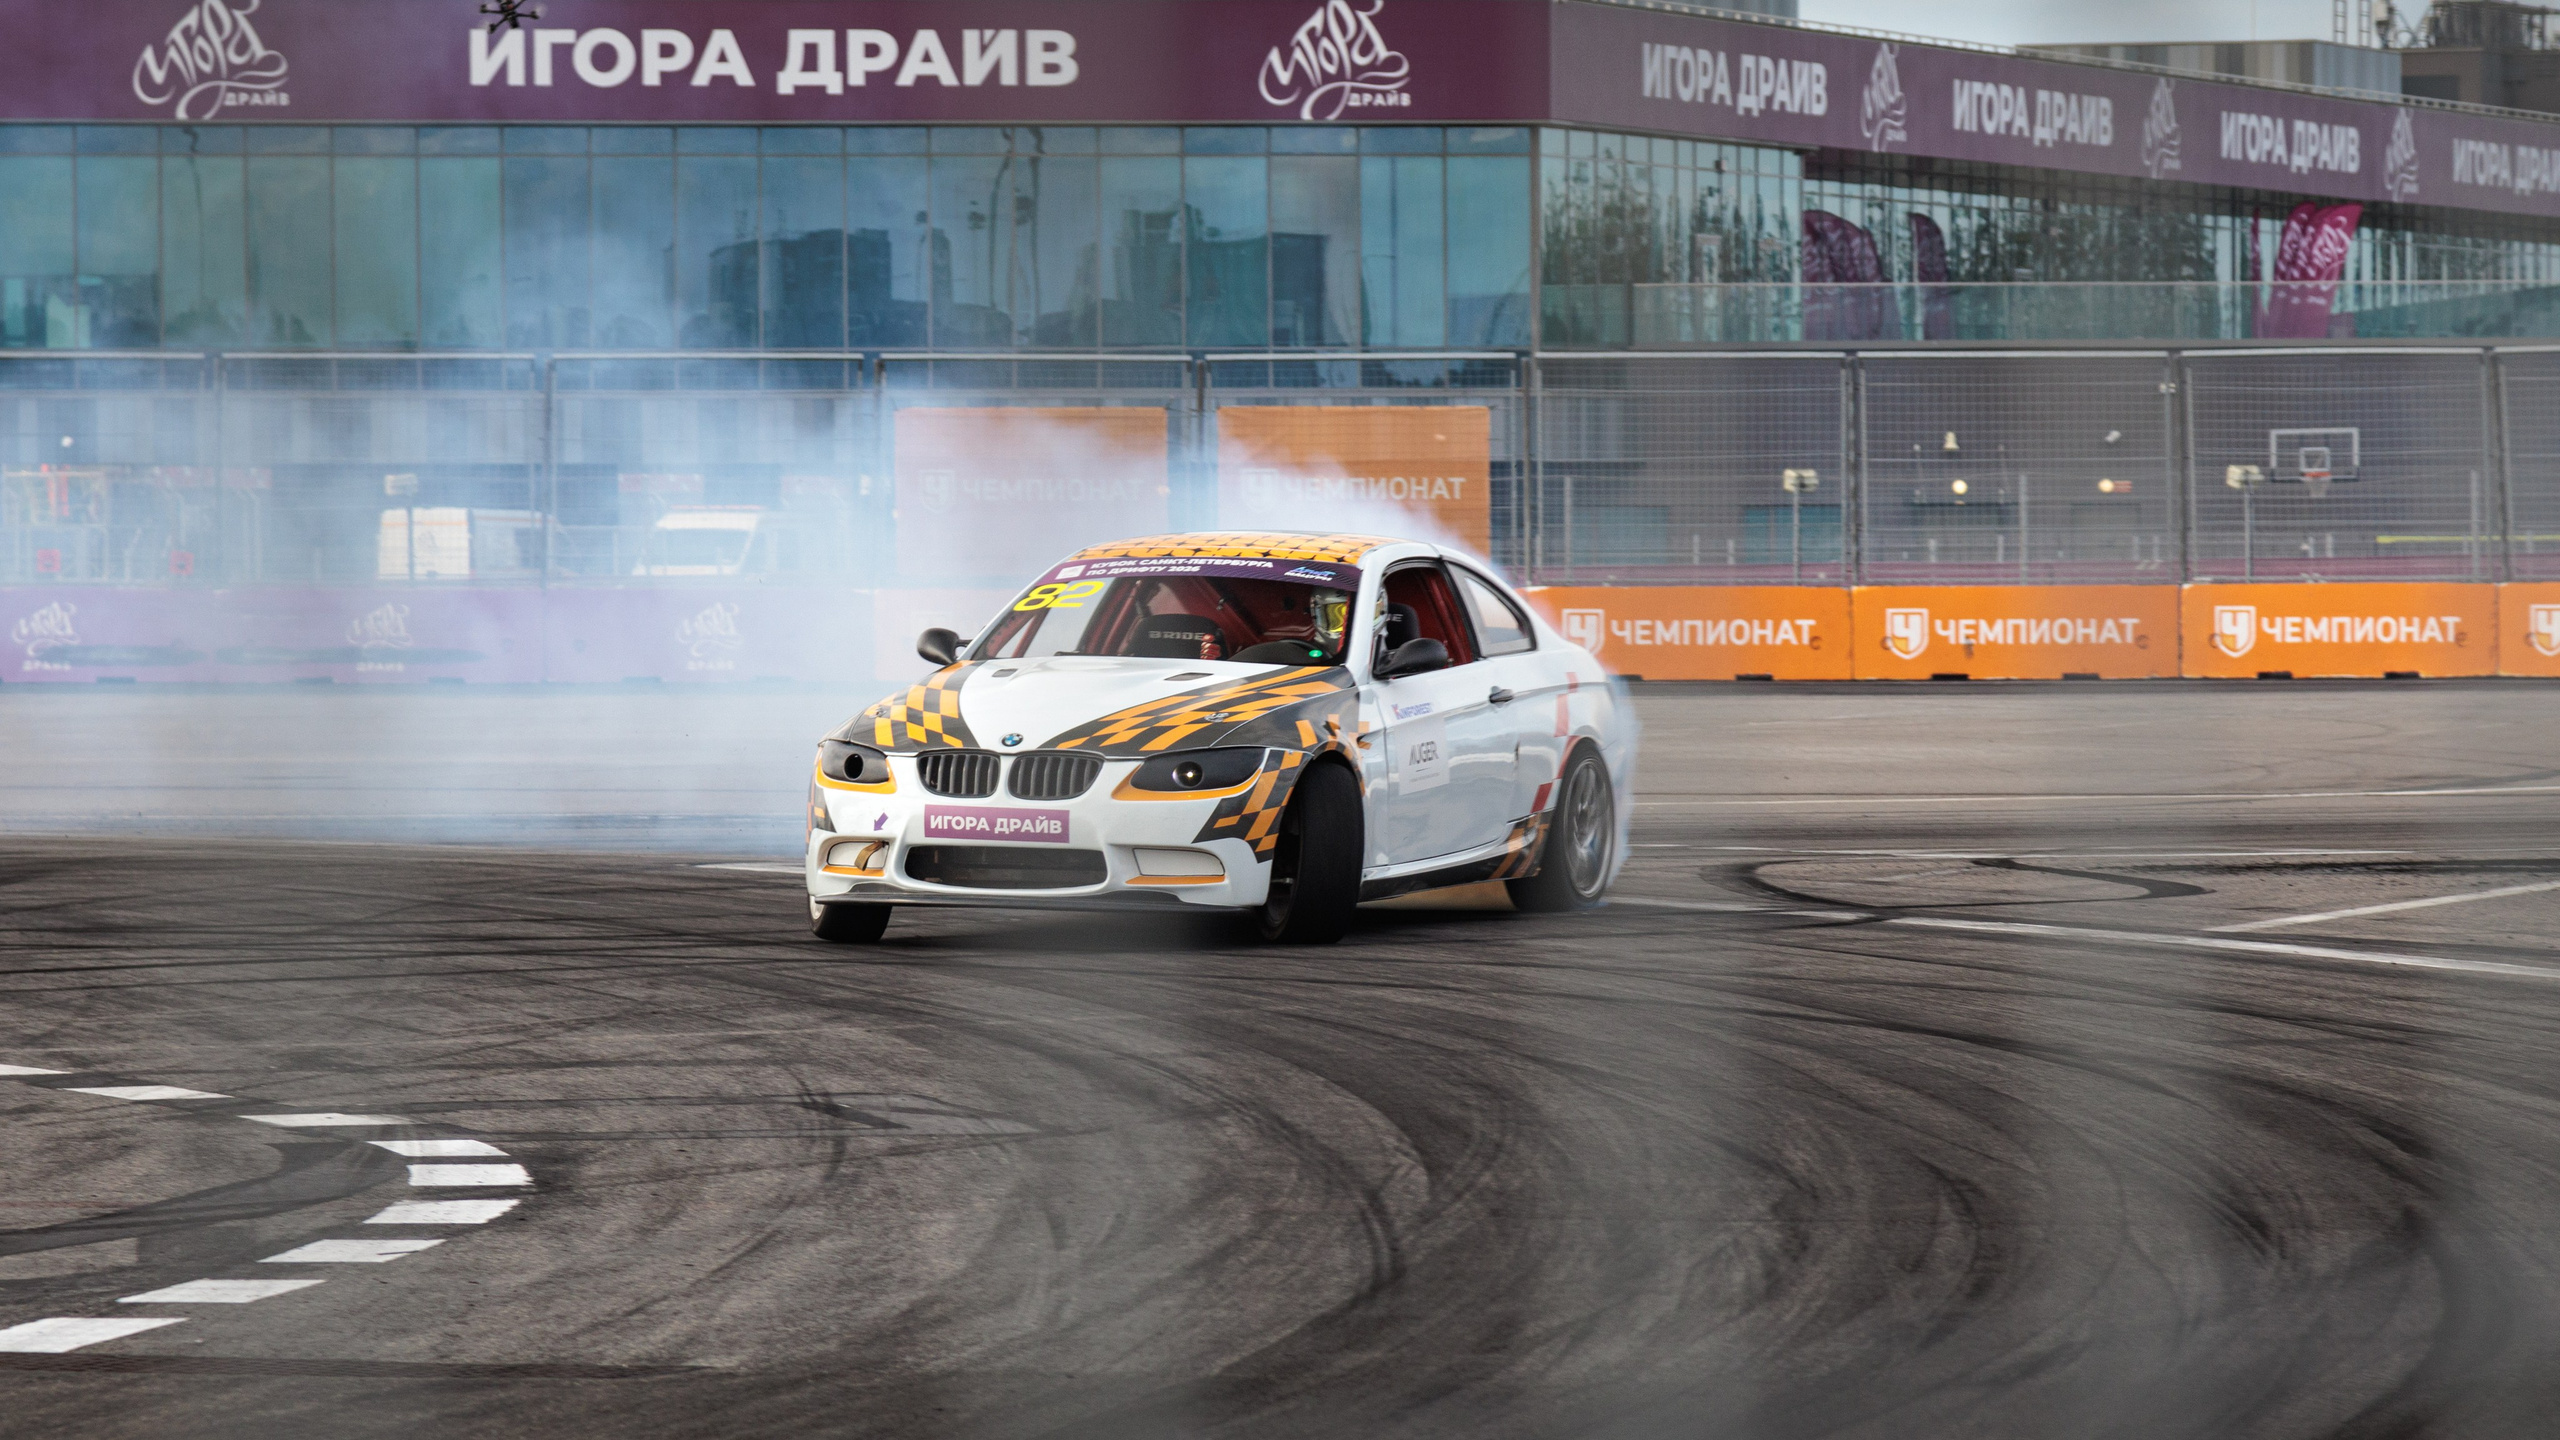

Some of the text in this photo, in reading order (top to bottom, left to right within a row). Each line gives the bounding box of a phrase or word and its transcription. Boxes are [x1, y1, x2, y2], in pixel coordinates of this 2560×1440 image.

[469, 27, 1079, 95] ИГОРА ДРАЙВ
[1642, 42, 1733, 106] ИГОРА
[224, 90, 290, 106] ДРАЙВ
[1348, 90, 1411, 107] ДРАЙВ
[1953, 78, 2031, 138] ИГОРА
[2220, 110, 2288, 165] ИГОРА
[2452, 138, 2512, 188] ИГОРА
[963, 478, 1144, 501] ЧЕМПИОНАТ
[1286, 476, 1467, 501] ЧЕМПИОНАТ
[1086, 568, 1107, 577] ПО
[1107, 566, 1167, 576] ДРИФТУ
[1091, 558, 1274, 569] КУБОК САНКТ-ПЕТЕРБУРГА
[1012, 581, 1105, 612] 82
[1148, 630, 1205, 640] BRIDE
[1611, 619, 1816, 645] ЧЕМПИОНАТ
[1935, 618, 2140, 644] ЧЕМПИОНАТ
[2261, 616, 2461, 643] ЧЕМПИОНАТ
[930, 815, 1063, 835] ИГОРА ДРАЙВ
